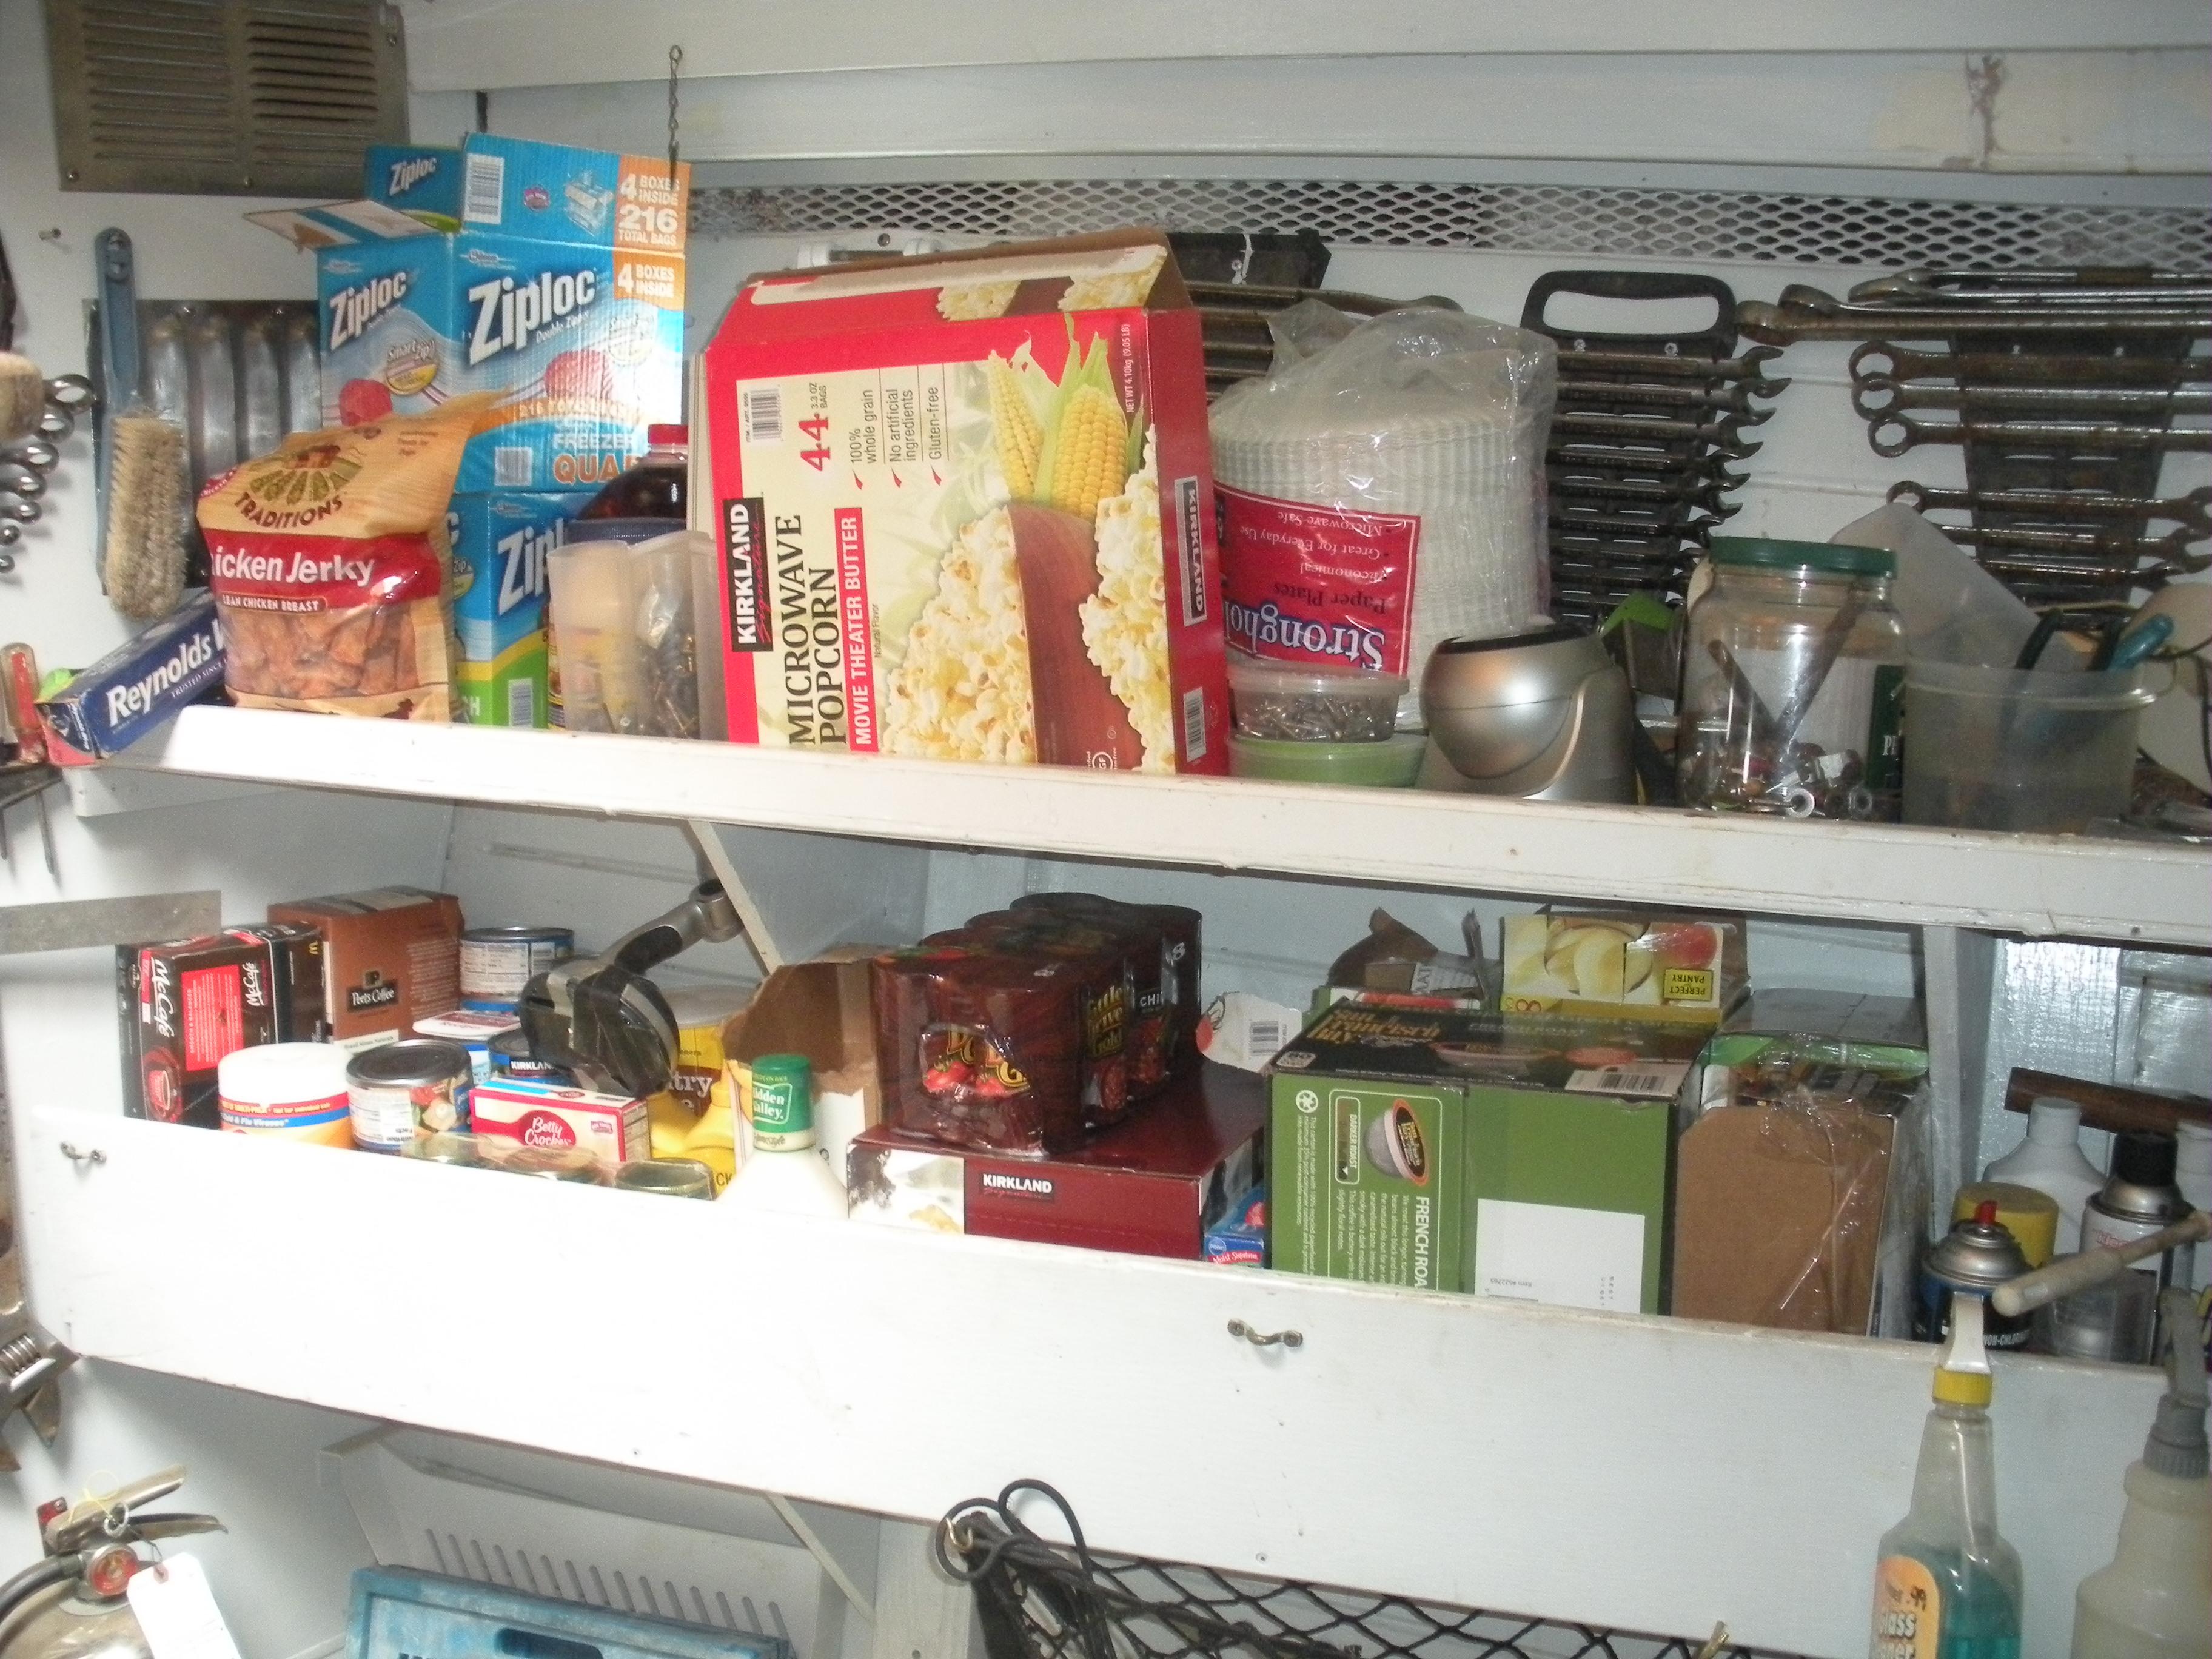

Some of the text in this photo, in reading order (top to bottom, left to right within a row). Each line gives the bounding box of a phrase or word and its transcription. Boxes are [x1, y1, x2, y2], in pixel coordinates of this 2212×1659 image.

[389, 156, 437, 196] Ziploc
[620, 175, 680, 198] 4 BOXES
[638, 189, 679, 206] INSIDE
[618, 203, 677, 234] 216
[618, 230, 677, 247] TOTAL BAGS
[617, 263, 675, 292] 4 BOXES
[635, 279, 674, 298] INSIDE
[329, 271, 407, 352] Ziploc
[468, 269, 597, 367] Ziploc
[1121, 324, 1134, 413] NET WT 4.10kg (9.05 LB)
[809, 382, 819, 410] 3.3 OZ
[819, 386, 828, 409] BAGS
[863, 389, 877, 464] whole grain
[888, 389, 900, 463] No artificial
[903, 389, 918, 462] ingredients
[928, 386, 942, 460] Gluten-free
[850, 428, 861, 464] 100%
[235, 492, 343, 529] TRADITIONS
[1278, 511, 1382, 537] Microwave Safe
[1188, 488, 1204, 612] KIRKLAND
[1239, 525, 1381, 560] Great for Everyday Use
[212, 546, 375, 586] icken Jerky
[498, 518, 565, 617] Zip
[729, 504, 757, 645] KIRKLAND
[1299, 562, 1381, 583] Economical
[243, 597, 278, 610] CHICKEN
[281, 598, 319, 612] BREAST
[1274, 583, 1387, 614] Paper Plates
[775, 515, 816, 745] MICROWAVE
[842, 517, 873, 746] MOVIE THEATER BUTTER
[808, 568, 846, 745] POPCORN
[106, 632, 212, 726] Reynolds
[1098, 757, 1107, 769] GF
[1669, 985, 1705, 995] PERFECT
[1672, 974, 1704, 984] PANTRY
[372, 987, 395, 1003] Coffee
[753, 1087, 785, 1105] idden
[532, 1117, 563, 1135] Betty
[753, 1104, 784, 1120] alley.
[1349, 1114, 1358, 1144] DARKER
[983, 1173, 1053, 1193] KIRKLAND
[1348, 1204, 1356, 1224] coffee
[1358, 1191, 1367, 1213] smoky
[1414, 1196, 1430, 1287] FRENCH ROA
